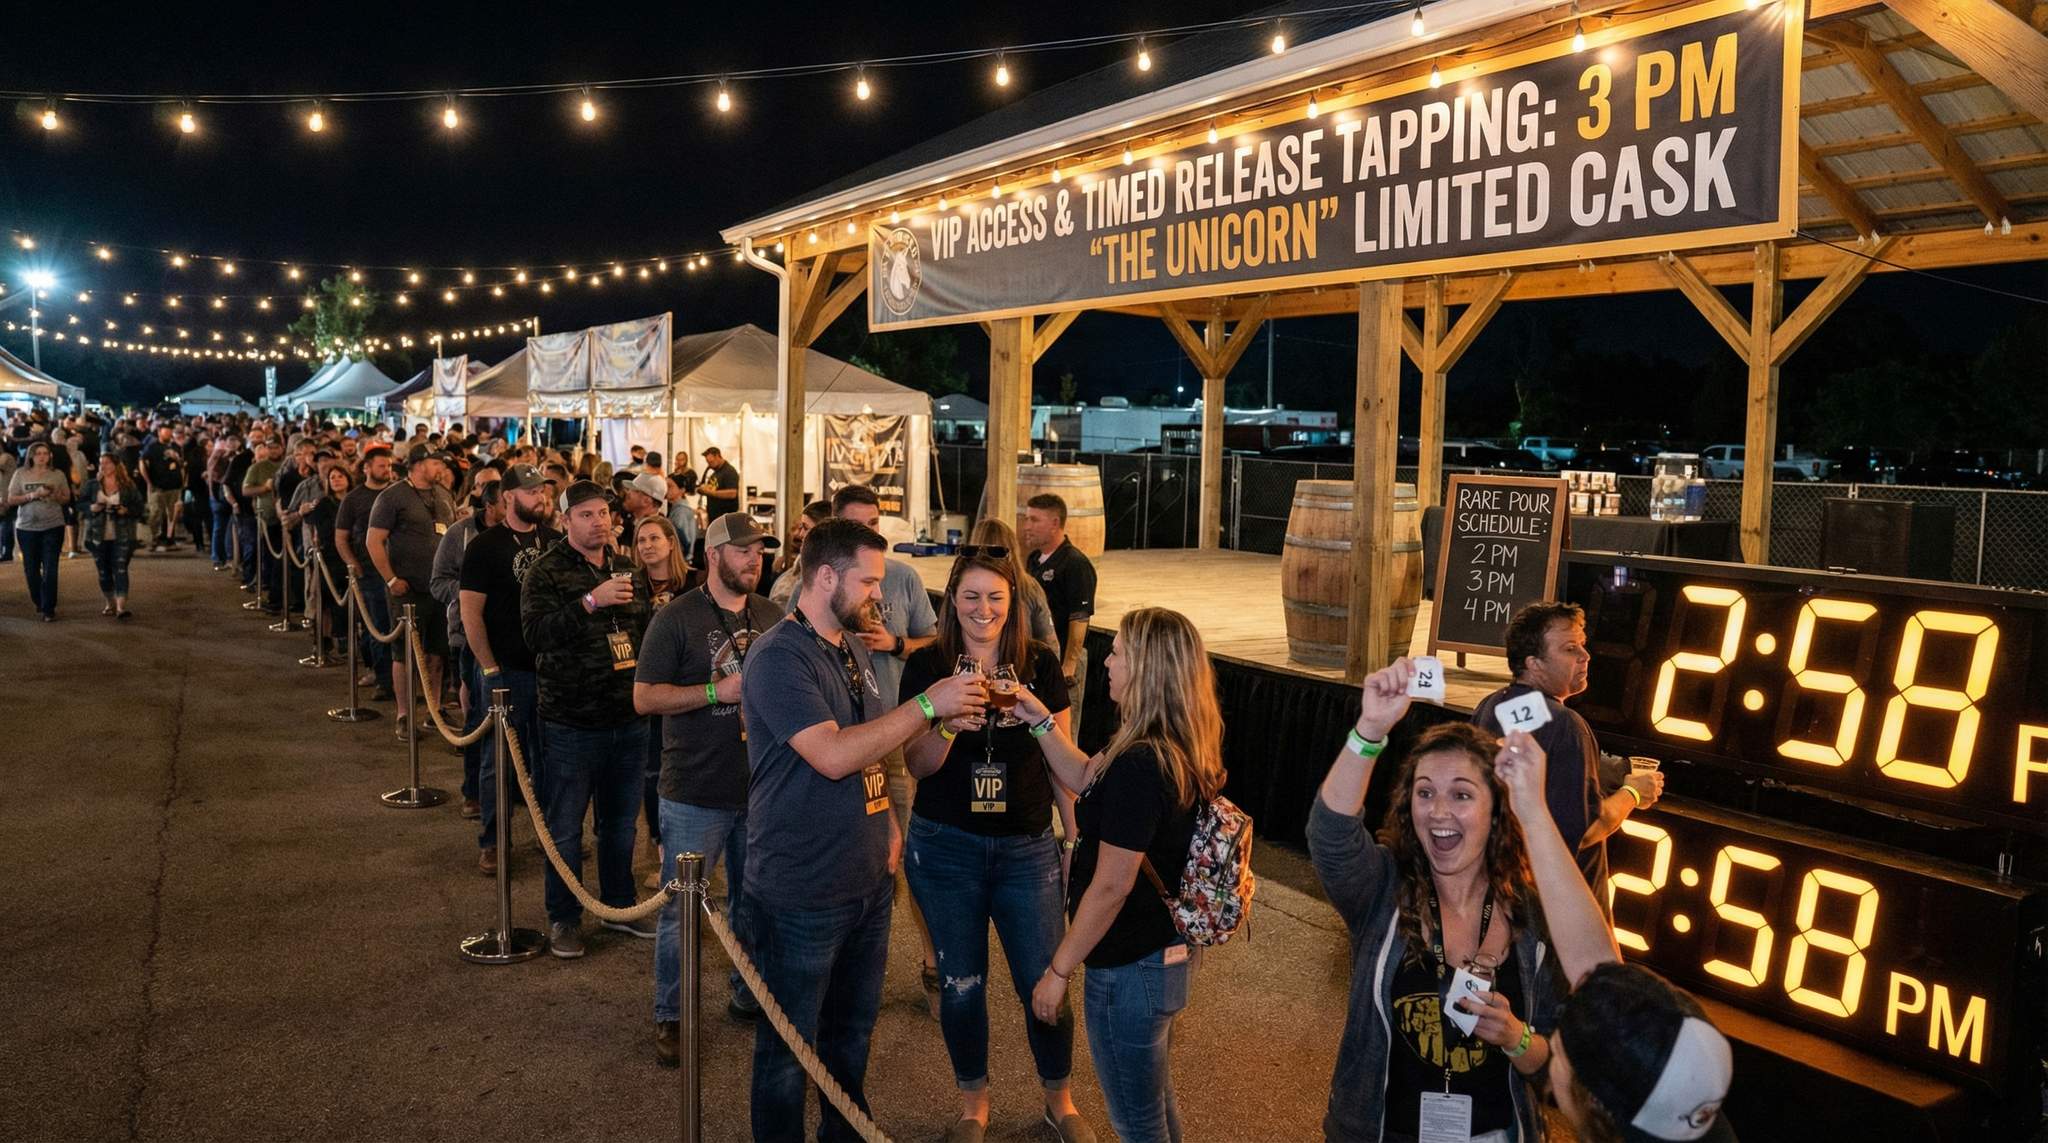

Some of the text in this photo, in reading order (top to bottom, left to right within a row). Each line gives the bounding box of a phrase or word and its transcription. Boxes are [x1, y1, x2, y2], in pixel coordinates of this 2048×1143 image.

[930, 32, 1738, 261] VIP ACCESS & TIMED RELEASE TAPPING: 3 PM
[1090, 126, 1737, 285] “THE UNICORN” LIMITED CASK
[1459, 488, 1552, 514] RARE POUR
[1458, 513, 1548, 536] SCHEDULE:
[1471, 543, 1518, 567] 2 PM
[1466, 570, 1515, 595] 3 PM
[1464, 598, 1511, 624] 4 PM
[613, 643, 631, 660] VIP
[1651, 585, 1999, 788] 2:58
[1510, 706, 1534, 724] 12
[865, 773, 884, 799] VIP
[974, 778, 1003, 799] VIP
[1608, 819, 1986, 1065] 2:58 PM
